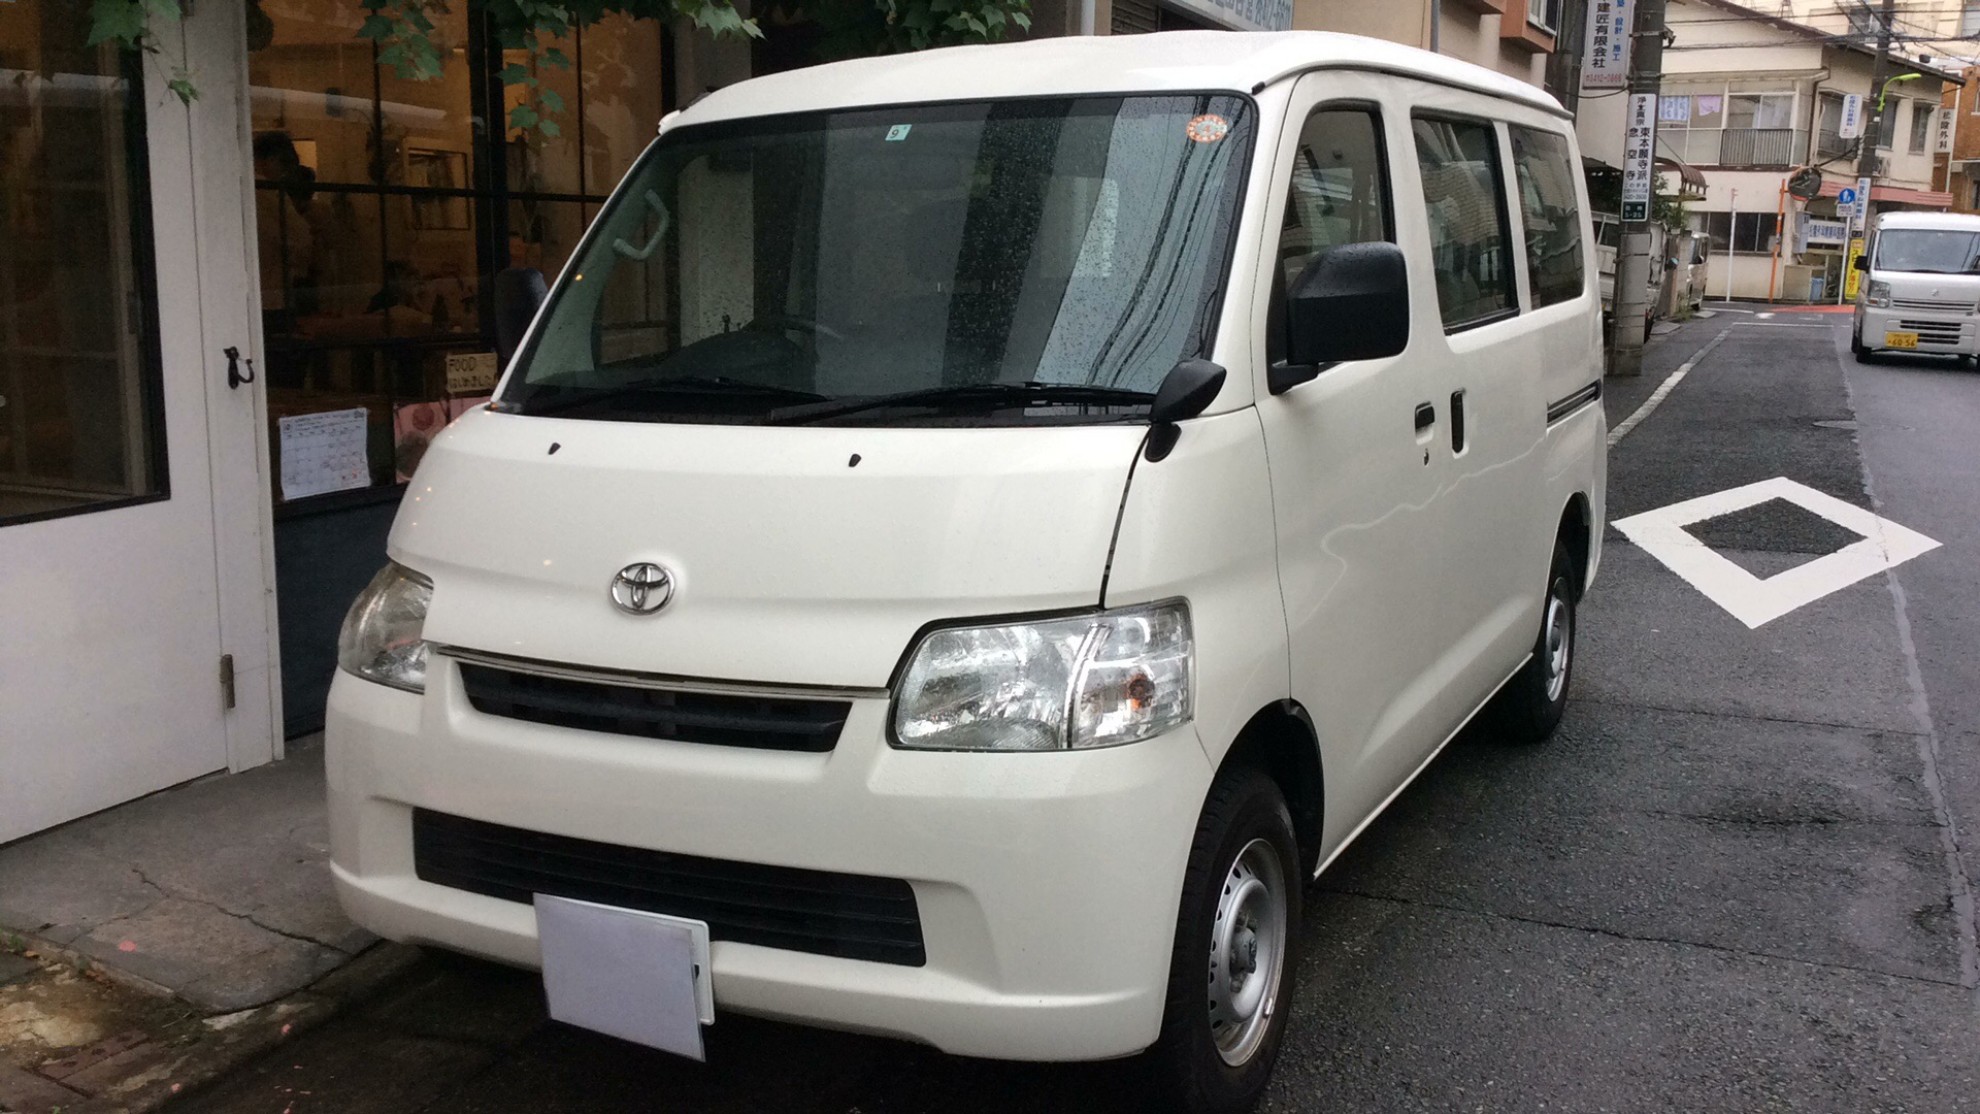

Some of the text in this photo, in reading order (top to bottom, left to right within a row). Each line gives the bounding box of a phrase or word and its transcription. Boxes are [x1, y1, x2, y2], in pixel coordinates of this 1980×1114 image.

[1637, 127, 1651, 180] 東本願寺派
[449, 356, 477, 371] FOOD
